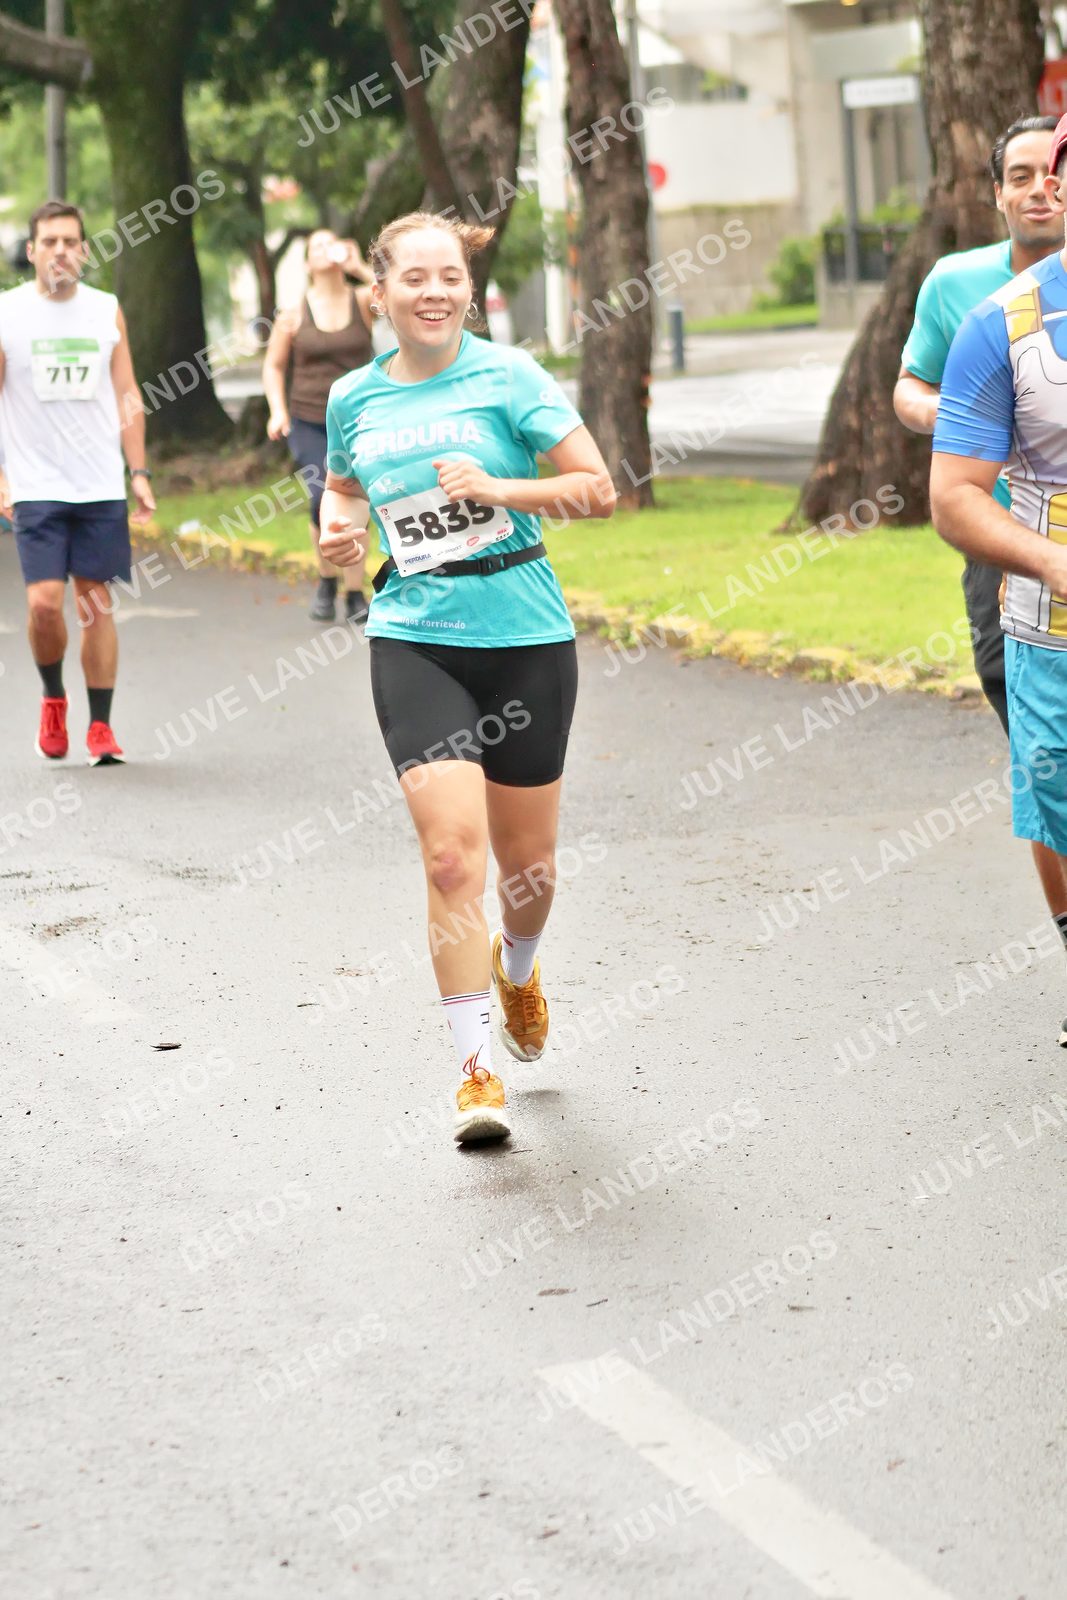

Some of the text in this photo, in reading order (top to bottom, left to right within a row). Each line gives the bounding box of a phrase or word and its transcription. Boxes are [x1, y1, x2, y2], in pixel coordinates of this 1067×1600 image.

[46, 366, 89, 384] 717
[394, 499, 495, 547] 5835
[404, 553, 432, 565] PERDURA
[421, 620, 466, 629] corriendo
